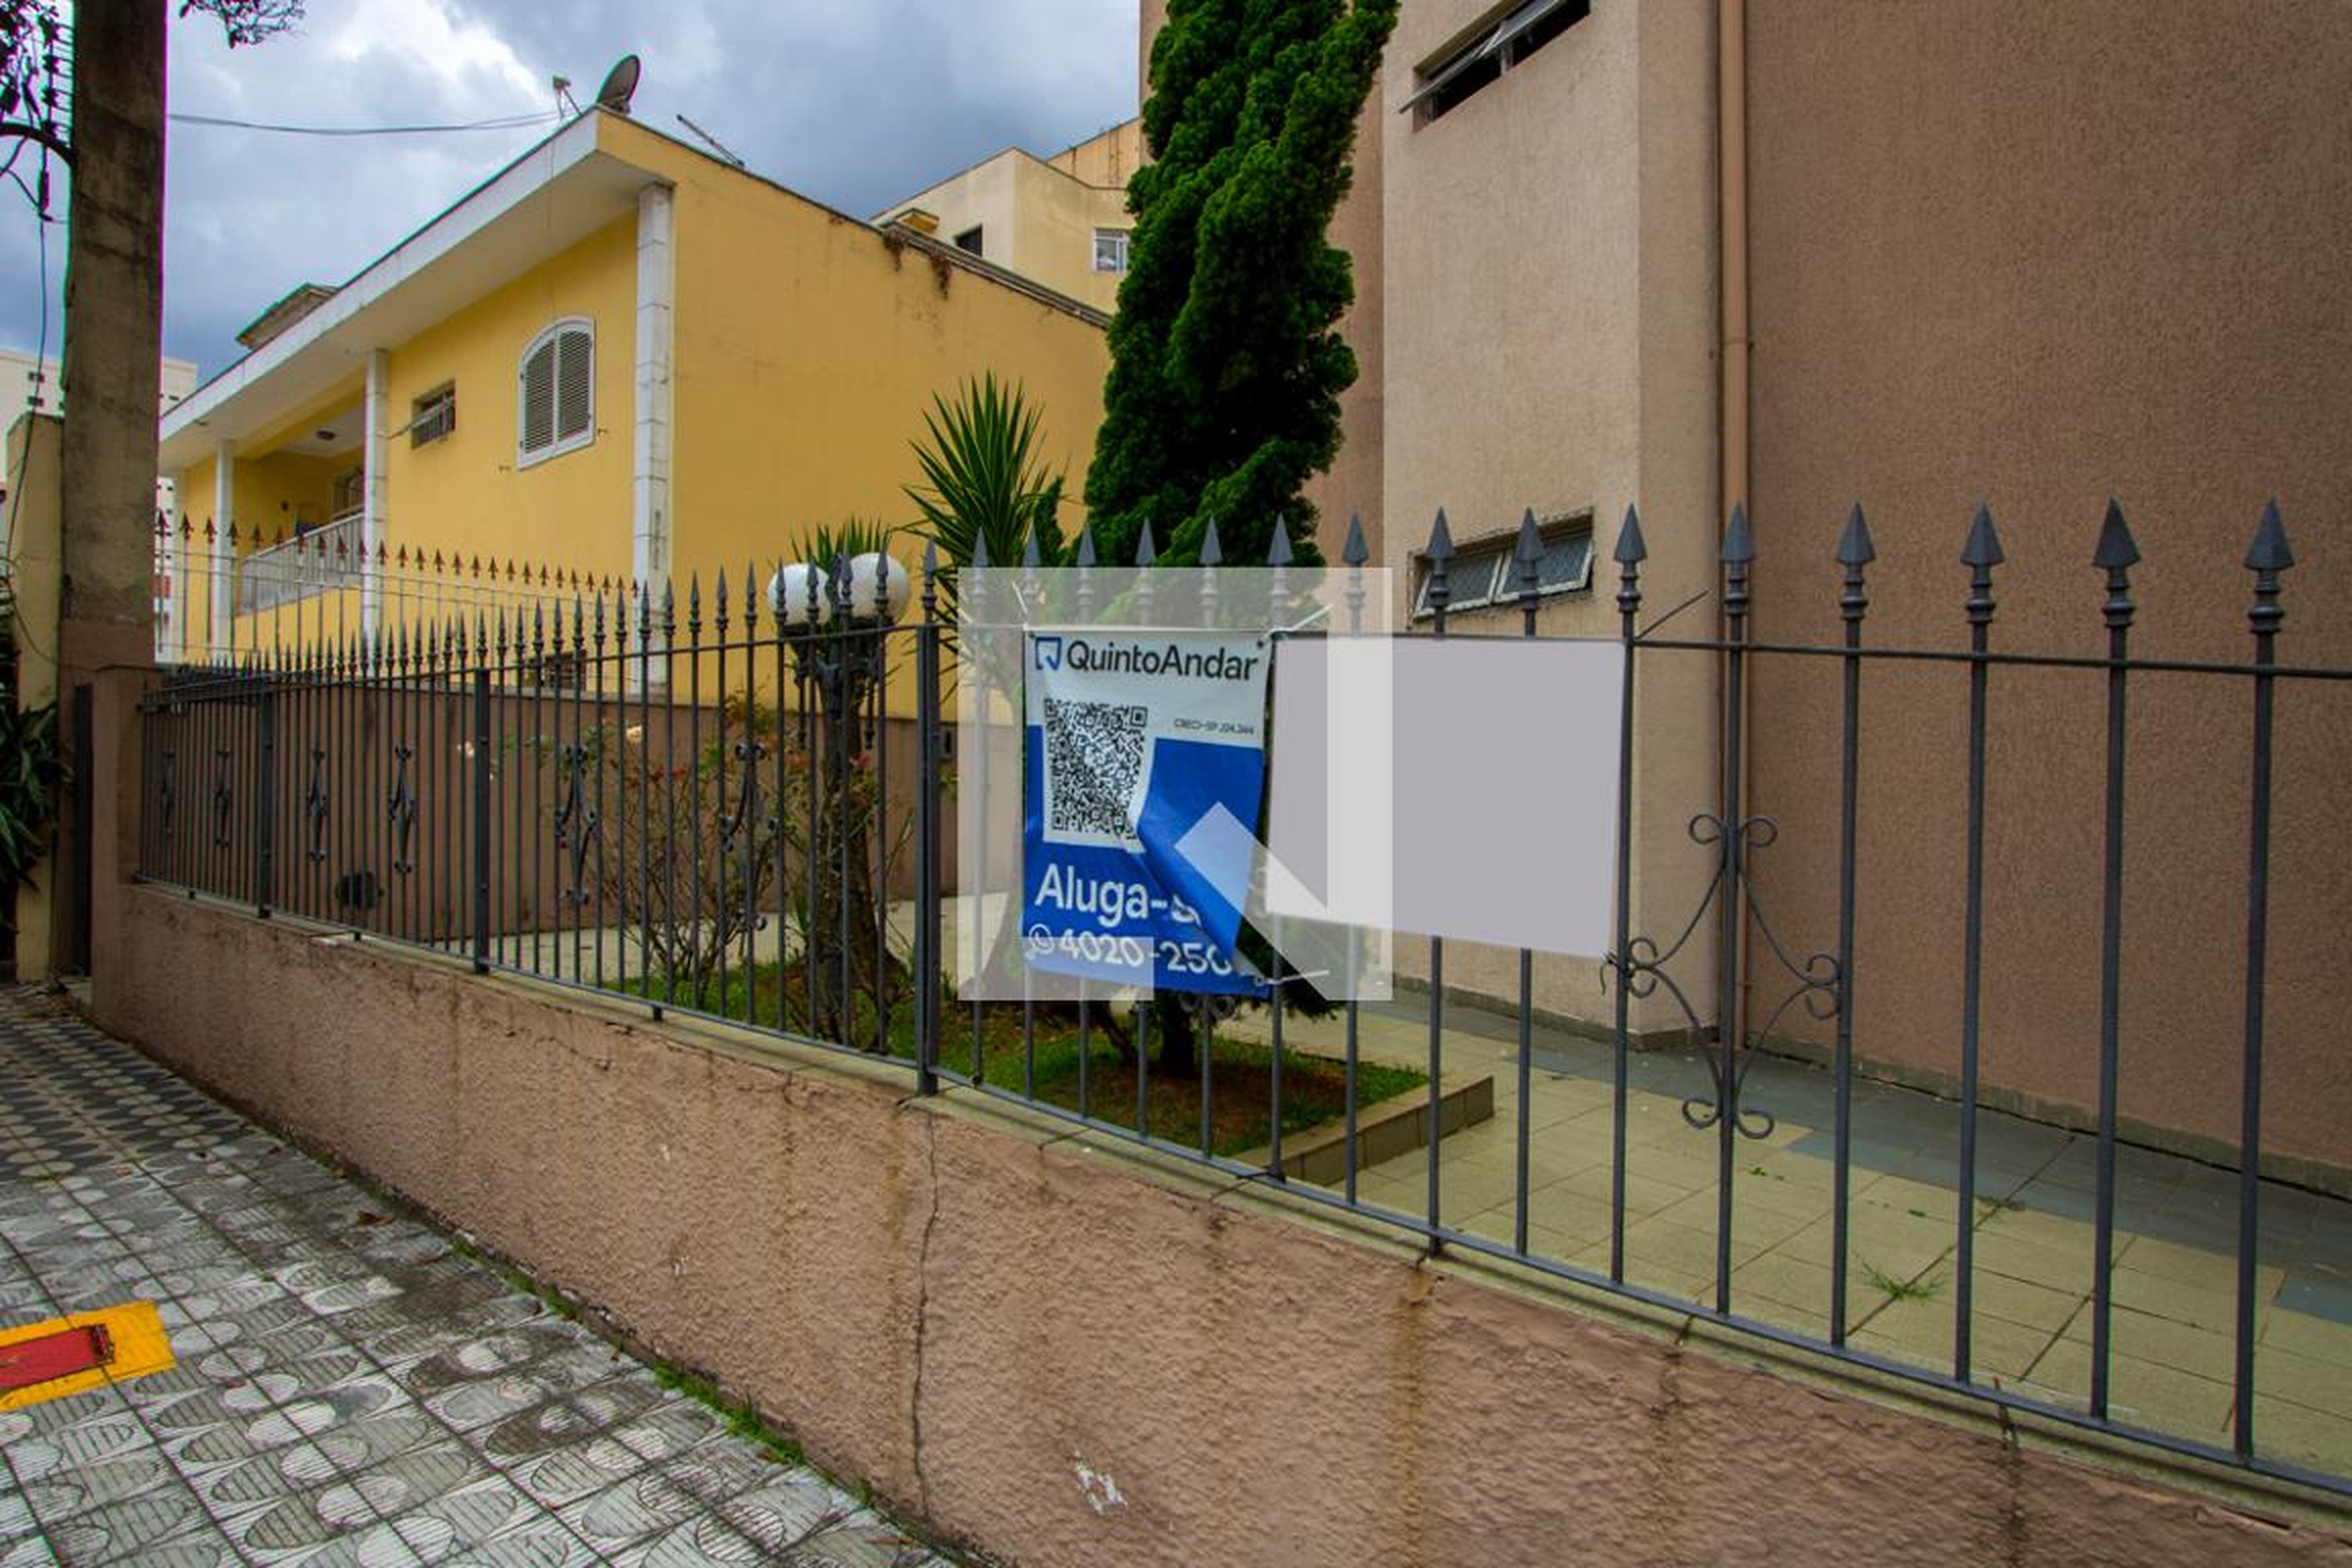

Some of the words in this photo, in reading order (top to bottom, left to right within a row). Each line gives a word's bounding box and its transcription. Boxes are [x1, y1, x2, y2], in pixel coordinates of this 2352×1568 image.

[1066, 639, 1259, 681] QuintoAndar
[1034, 862, 1202, 928] Aluga-s
[1060, 928, 1233, 976] 4020-250
